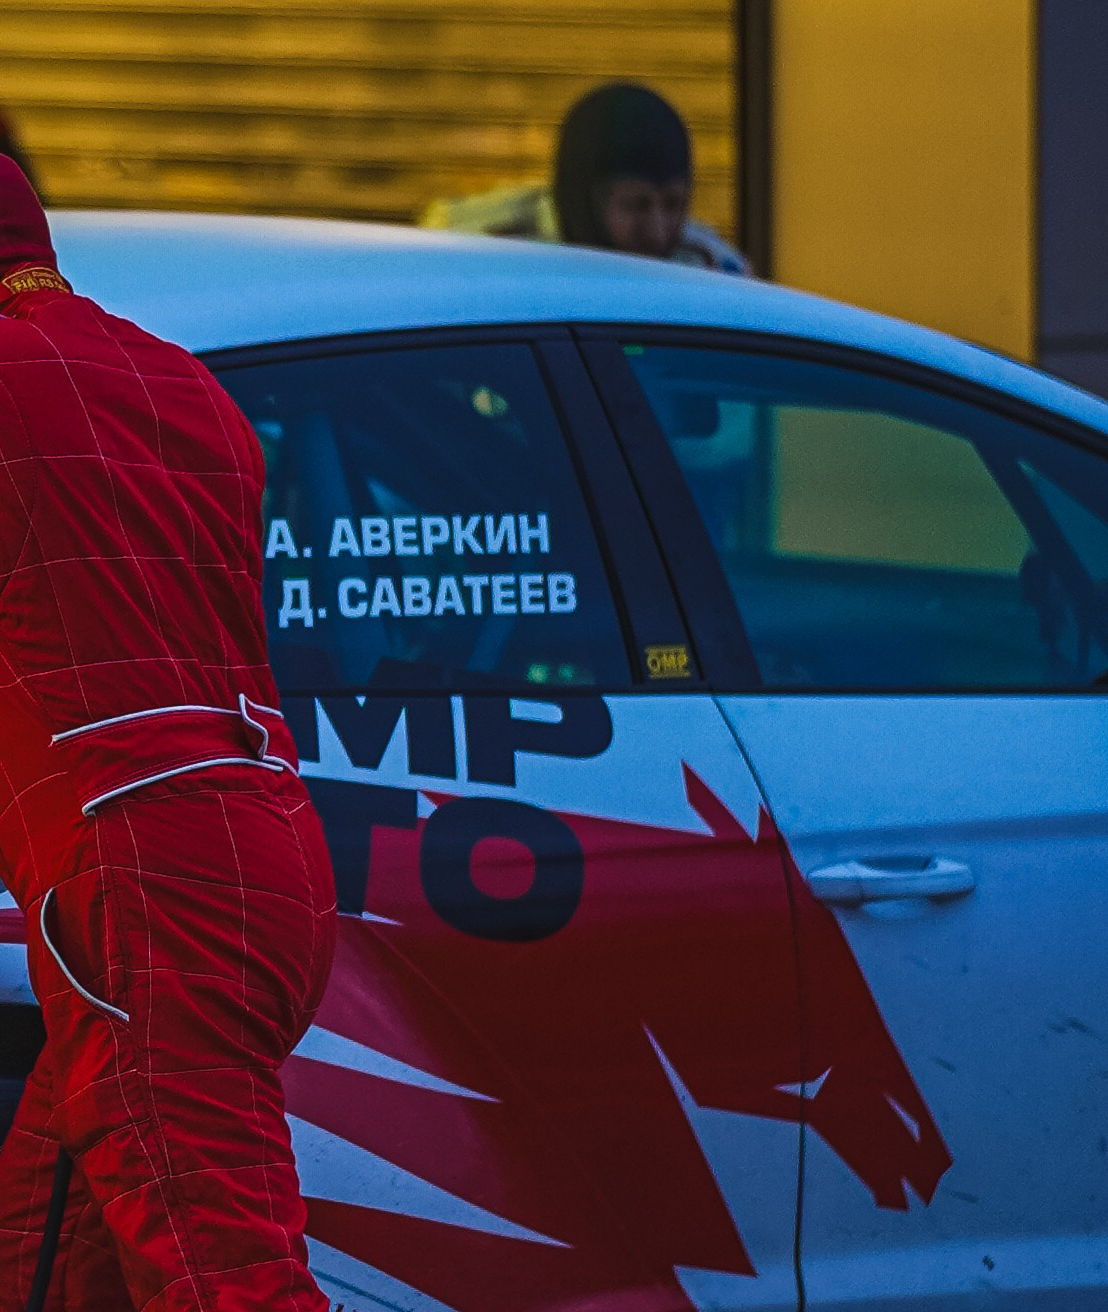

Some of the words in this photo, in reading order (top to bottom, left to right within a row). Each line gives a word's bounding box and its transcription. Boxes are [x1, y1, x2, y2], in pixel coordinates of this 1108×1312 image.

[265, 516, 312, 559] А.
[329, 513, 551, 559] АВЕРКИН
[278, 578, 327, 629] Д.
[337, 572, 578, 619] САВАТЕЕВ
